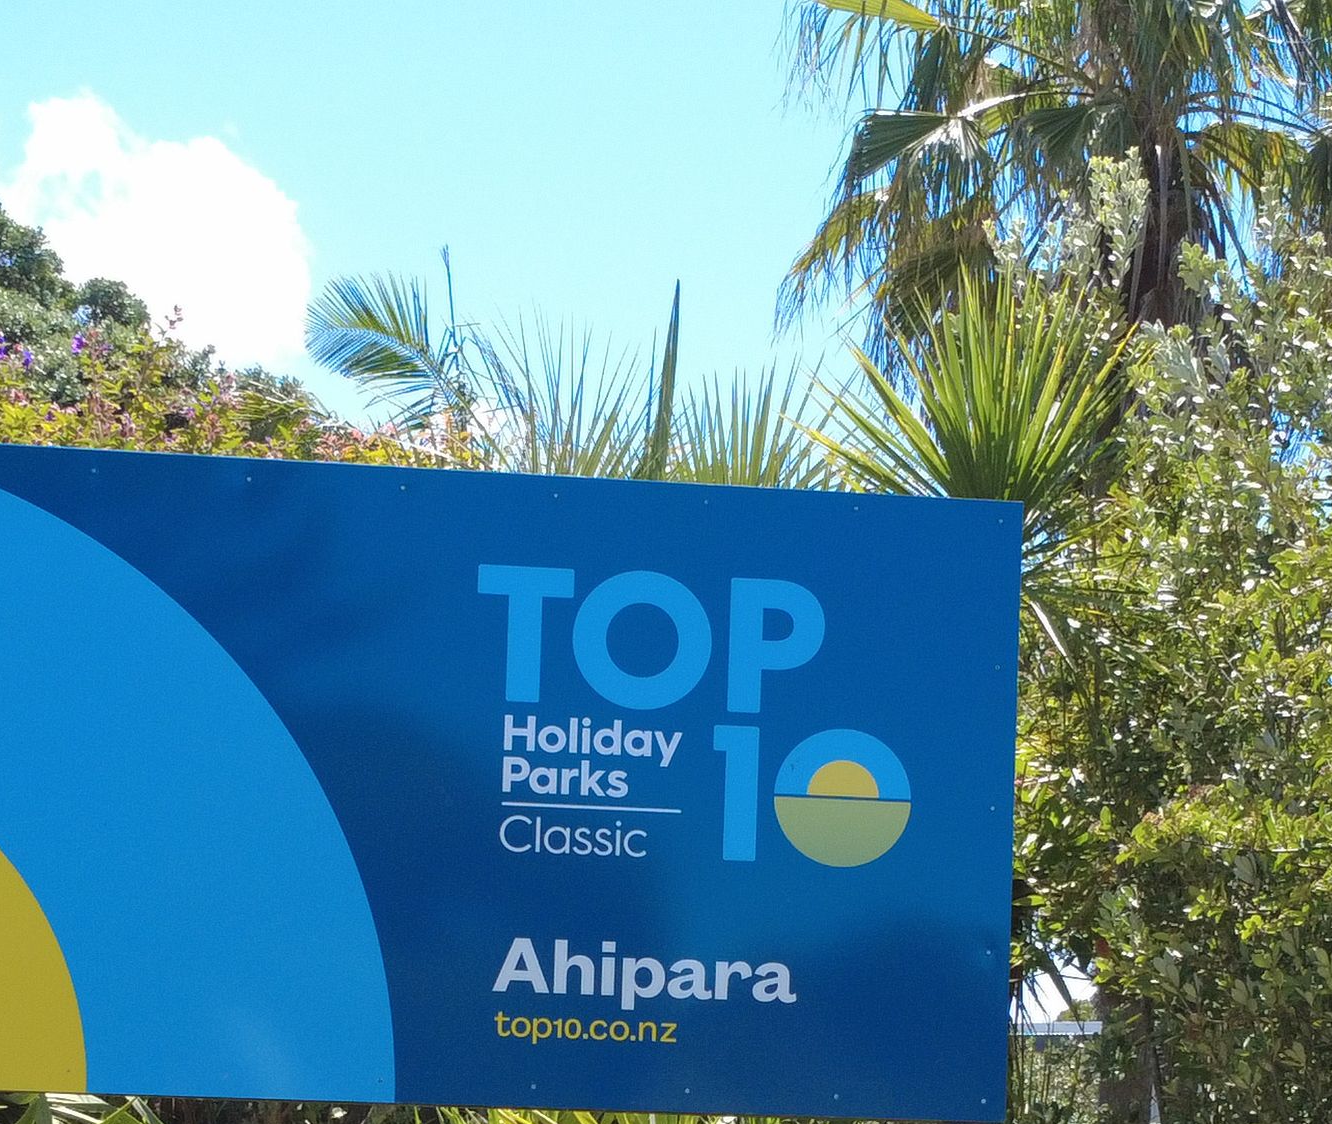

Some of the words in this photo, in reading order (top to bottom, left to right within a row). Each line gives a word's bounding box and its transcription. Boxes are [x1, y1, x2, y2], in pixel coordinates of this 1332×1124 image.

[478, 564, 825, 713] TOP
[503, 715, 682, 767] Holiday
[501, 757, 629, 798] Parks
[713, 725, 911, 867] 10
[499, 815, 648, 857] Classic
[492, 937, 797, 1011] Ahipara
[494, 1011, 677, 1044] top10.co.nz
